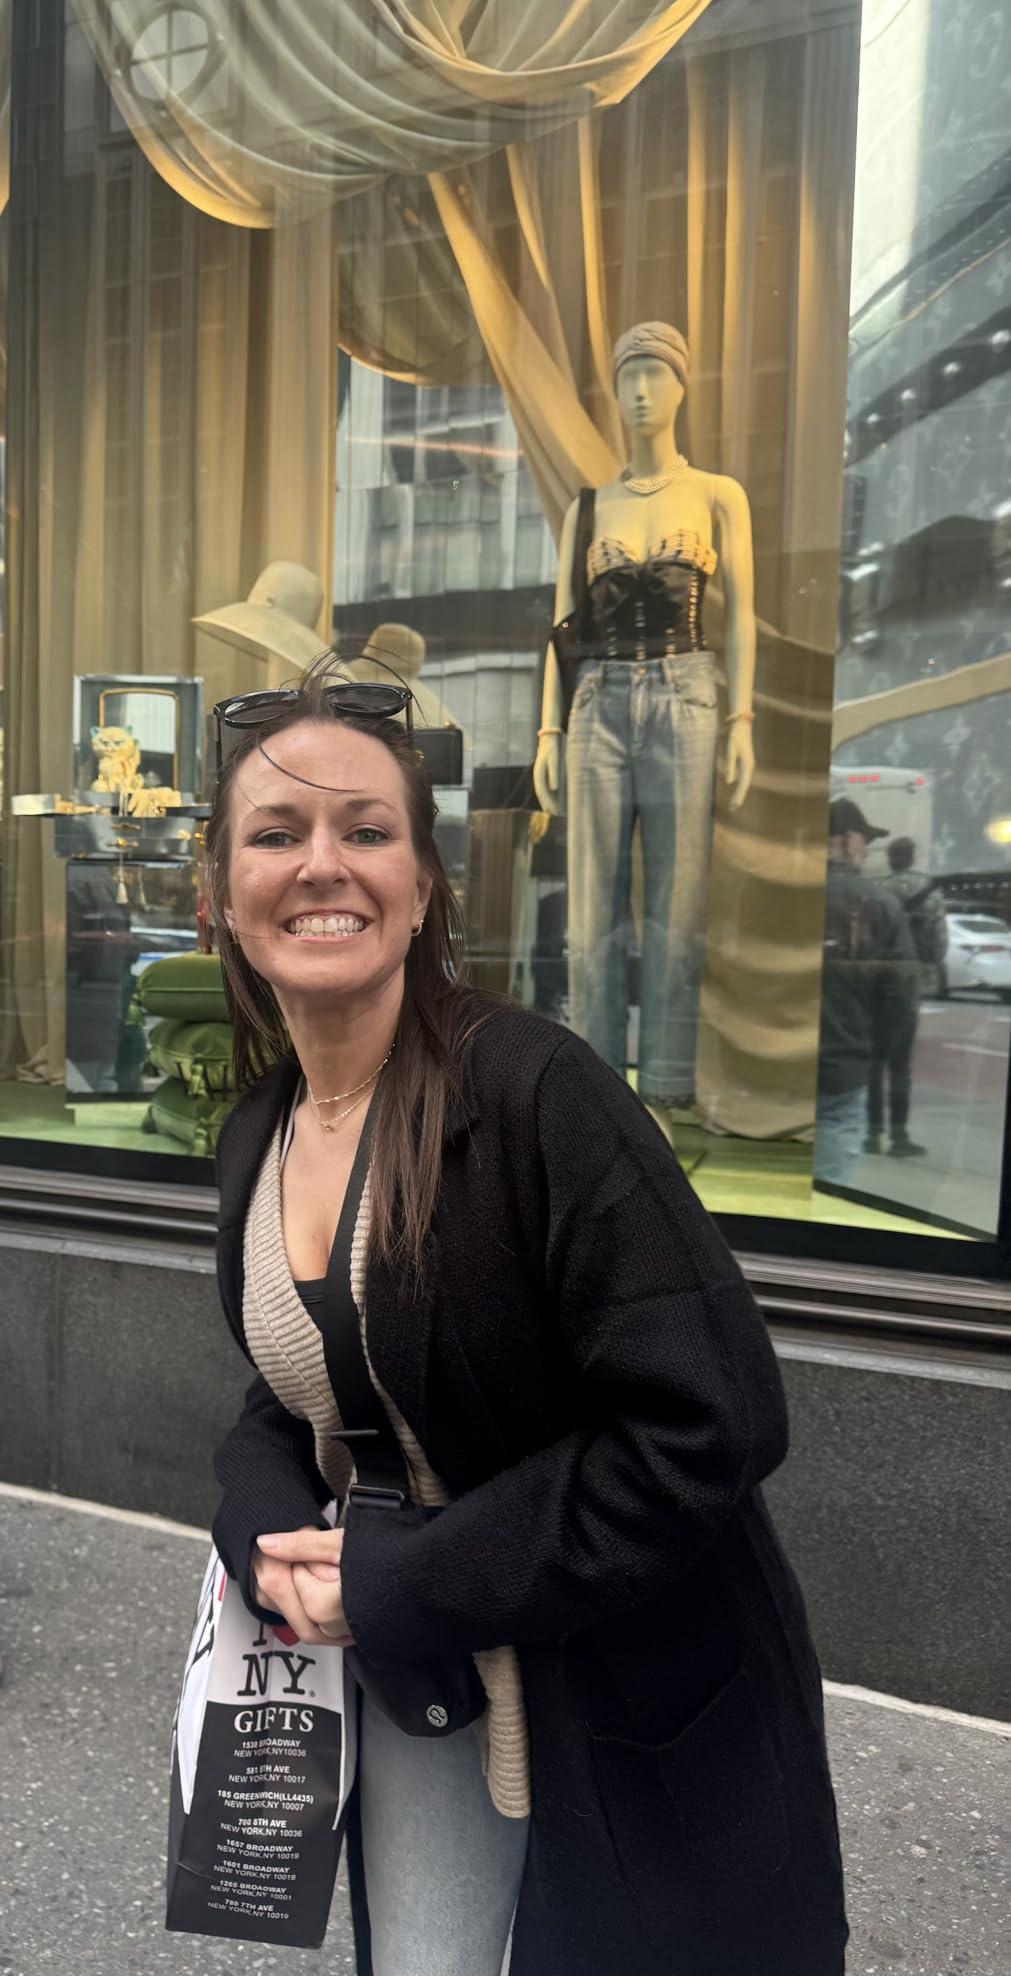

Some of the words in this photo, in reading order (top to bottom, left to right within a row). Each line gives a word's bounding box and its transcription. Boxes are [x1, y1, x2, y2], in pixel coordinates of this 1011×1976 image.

[234, 1706, 314, 1733] GIFTS
[259, 1738, 301, 1748] BROADWAY
[233, 1749, 252, 1758] NEW
[246, 1766, 258, 1775] 581
[273, 1765, 291, 1774] AVE
[228, 1774, 248, 1783] NEW
[283, 1775, 306, 1783] 10017
[217, 1789, 232, 1798] 185
[224, 1799, 245, 1808] NEW
[282, 1802, 305, 1811] 10007
[238, 1818, 251, 1826] 700
[253, 1818, 269, 1826] 8TH
[269, 1819, 287, 1828] AVE
[220, 1822, 240, 1833] NEW
[280, 1829, 303, 1838] 10036
[226, 1839, 245, 1848] 1657
[246, 1843, 293, 1853] BROADWAY
[216, 1844, 237, 1853] NEW
[277, 1852, 300, 1860] 10019
[213, 1865, 233, 1874] NEW
[223, 1860, 241, 1868] 1601
[243, 1863, 290, 1873] BROADWAY
[210, 1884, 230, 1893] NEW
[270, 1893, 292, 1901] 10001
[240, 1884, 287, 1894] BROADWAY
[207, 1902, 226, 1910] NEW
[267, 1911, 290, 1919] 10019
[240, 1902, 256, 1910] 7TH
[257, 1904, 274, 1912] AVE
